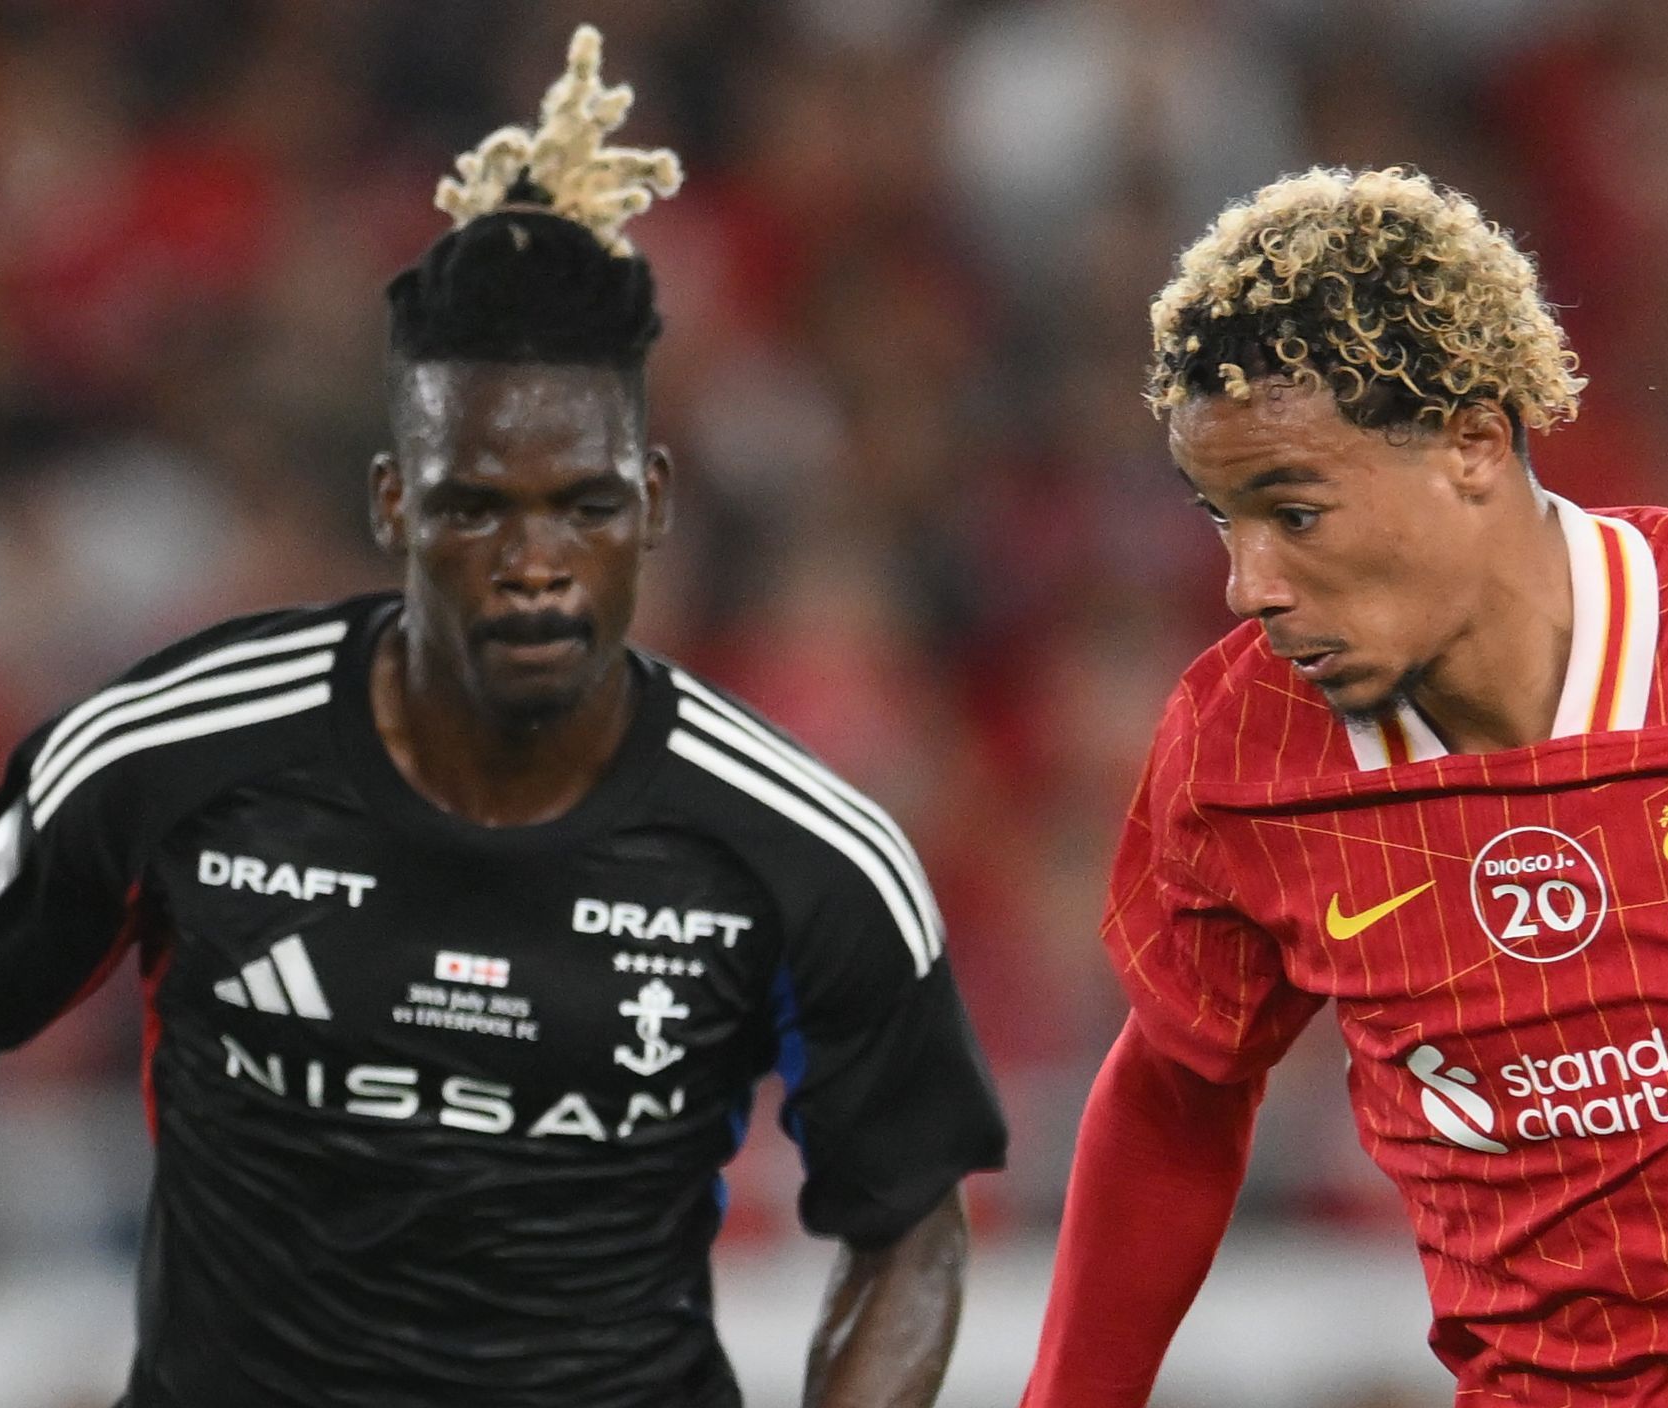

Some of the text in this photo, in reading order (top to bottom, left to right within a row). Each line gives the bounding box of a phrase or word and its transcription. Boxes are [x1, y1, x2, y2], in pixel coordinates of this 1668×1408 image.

[197, 849, 378, 909] DRAFT
[1484, 854, 1552, 877] DIOGO
[572, 897, 753, 948] DRAFT
[1491, 879, 1587, 939] 20
[221, 1033, 685, 1141] NISSAN
